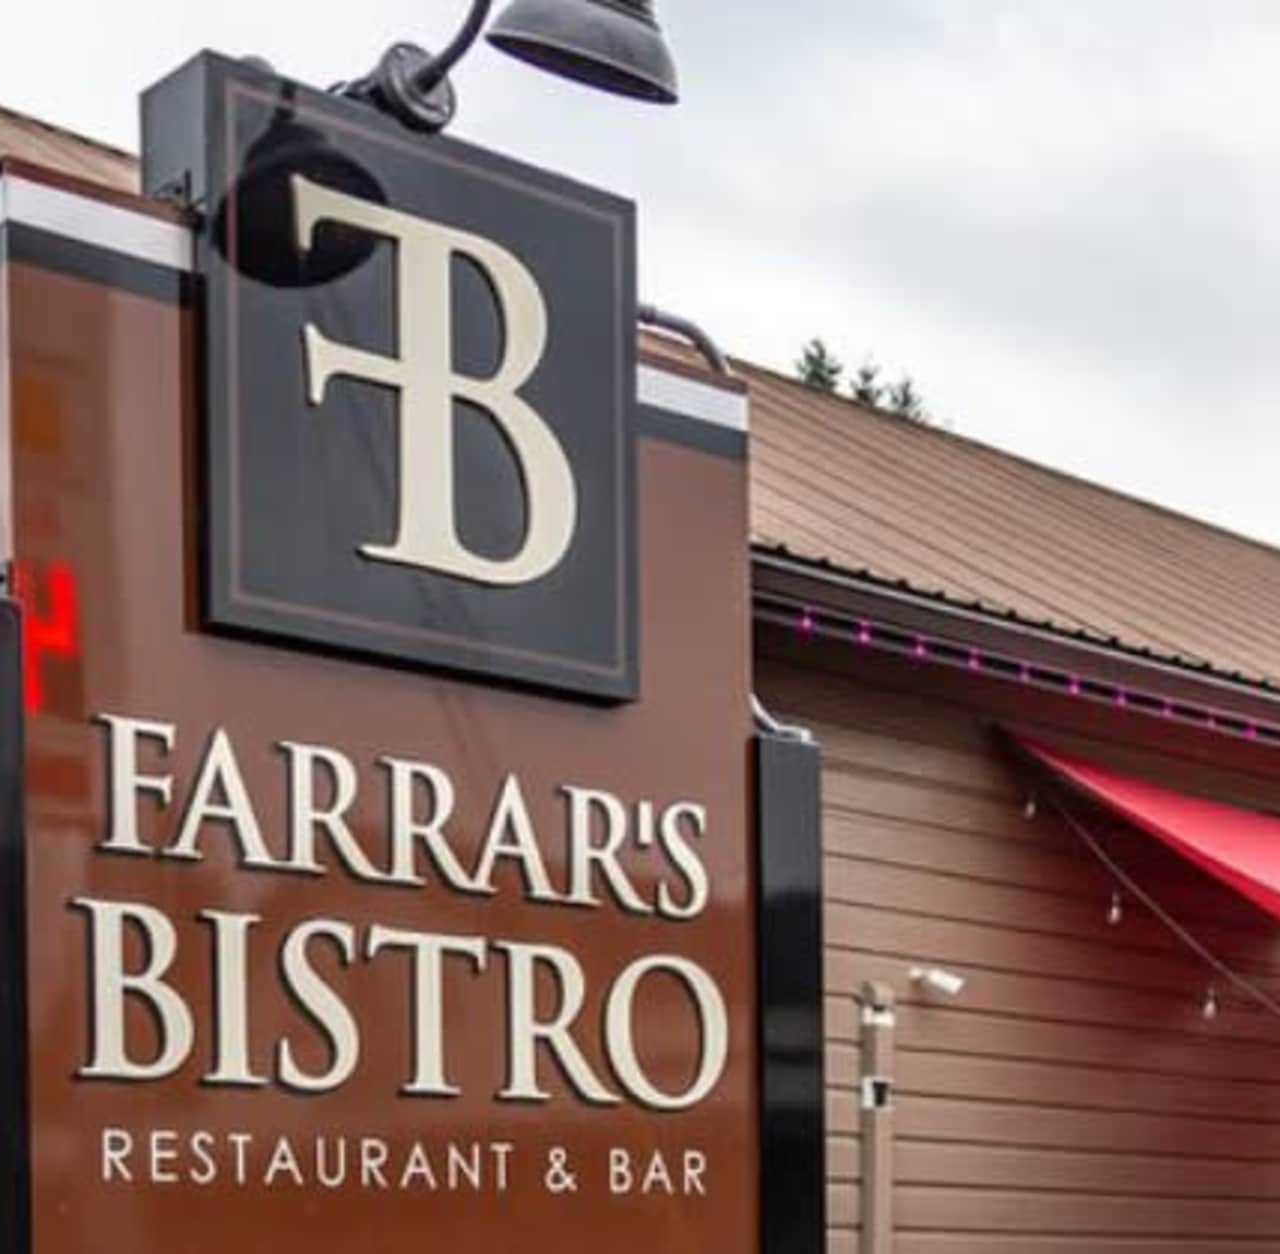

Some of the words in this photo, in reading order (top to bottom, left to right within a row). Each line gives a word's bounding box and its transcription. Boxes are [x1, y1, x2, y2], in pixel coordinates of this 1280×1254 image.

[95, 712, 710, 920] FARRAR'S
[69, 896, 730, 1113] BISTRO
[100, 1129, 514, 1192] RESTAURANT
[545, 1145, 578, 1194] &
[608, 1148, 709, 1195] BAR
